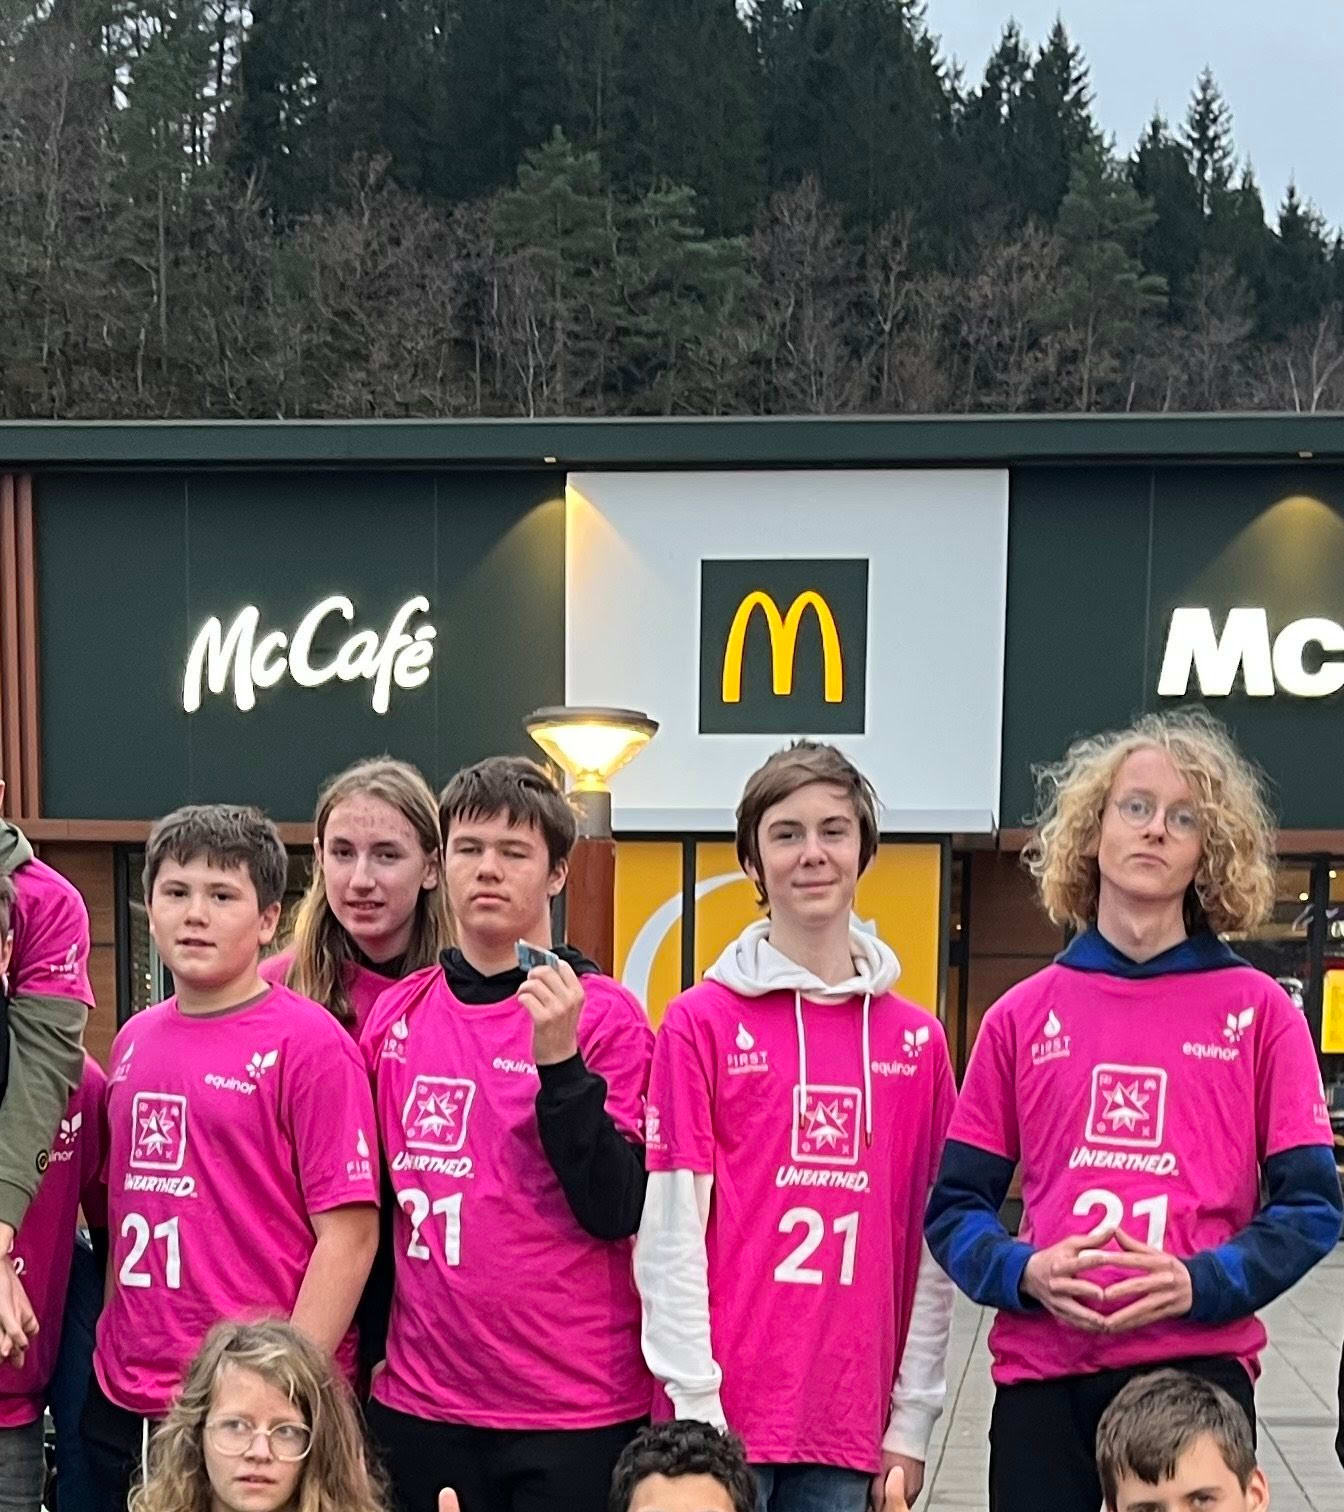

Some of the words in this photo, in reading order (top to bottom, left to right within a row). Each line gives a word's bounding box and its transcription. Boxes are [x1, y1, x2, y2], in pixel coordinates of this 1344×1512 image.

[182, 595, 437, 713] McCafé
[204, 1073, 257, 1096] equinor
[1182, 1042, 1240, 1061] equinor
[119, 1213, 181, 1289] 21
[397, 1188, 463, 1266] 21
[774, 1207, 859, 1285] 21
[1072, 1189, 1168, 1259] 21
